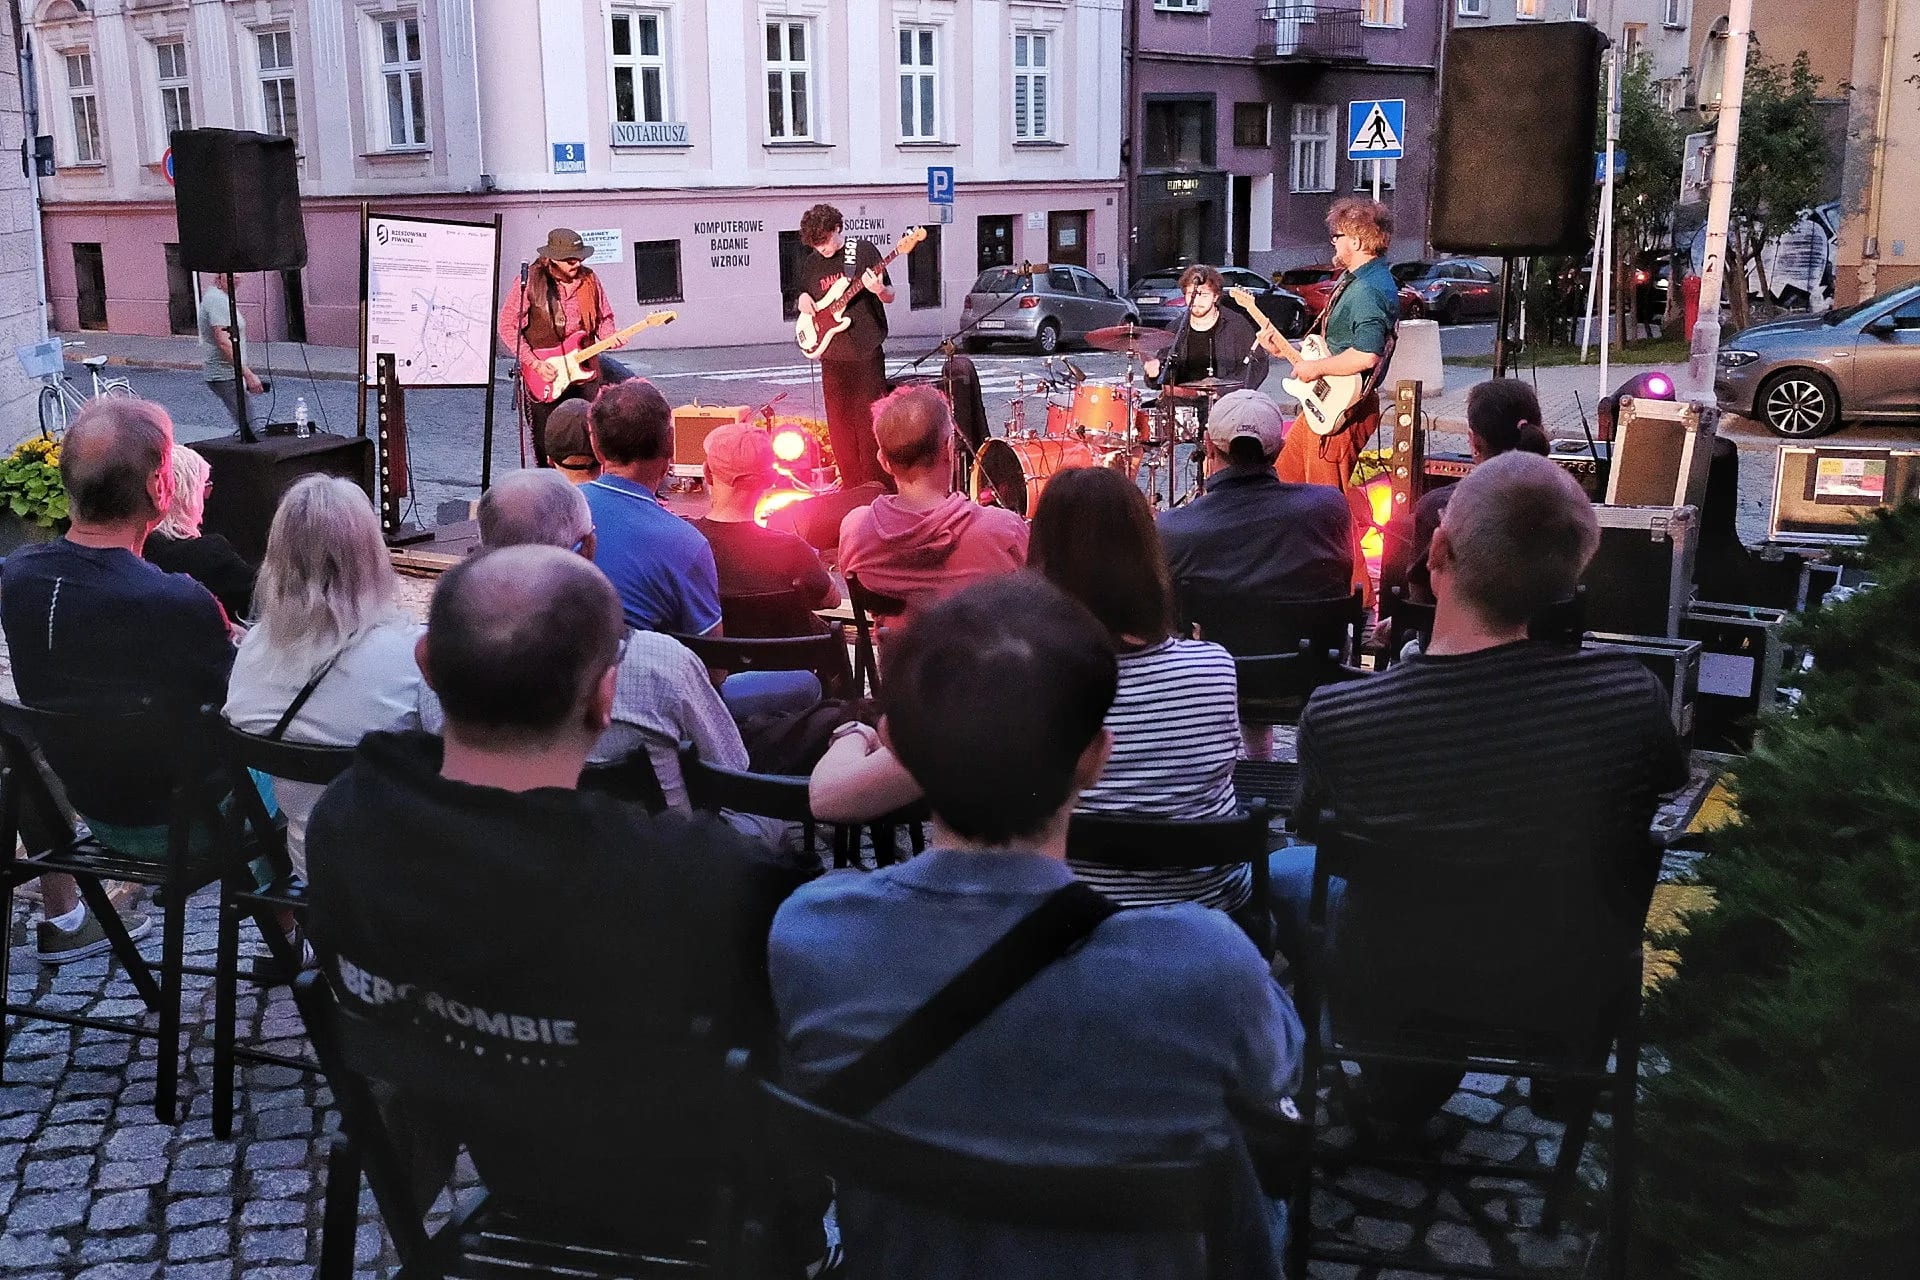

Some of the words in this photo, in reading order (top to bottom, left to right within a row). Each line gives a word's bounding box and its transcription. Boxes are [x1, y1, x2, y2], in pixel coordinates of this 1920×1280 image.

[617, 125, 686, 142] NOTARIUSZ
[565, 144, 575, 160] 3
[933, 170, 948, 199] P
[694, 220, 764, 235] KOMPUTEROWE
[844, 218, 885, 231] SOCZEWKI
[710, 237, 749, 251] BADANIE
[710, 254, 750, 268] WZROKU
